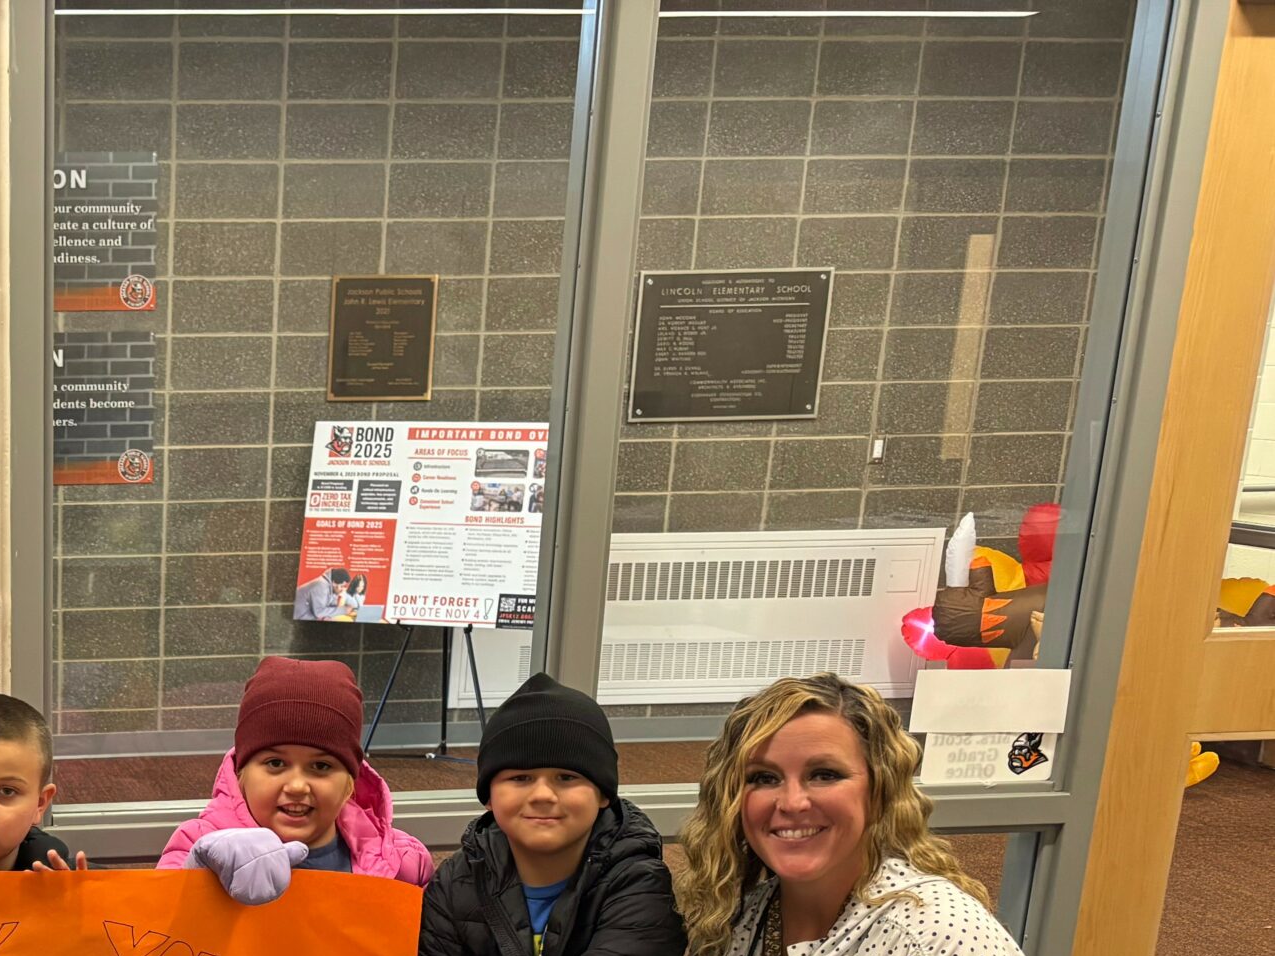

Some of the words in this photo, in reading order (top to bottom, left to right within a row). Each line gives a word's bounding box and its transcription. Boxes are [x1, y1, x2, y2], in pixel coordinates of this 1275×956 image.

[75, 202, 141, 215] community
[82, 222, 89, 230] a
[93, 219, 137, 230] culture
[140, 219, 153, 230] of
[99, 236, 122, 247] and
[661, 288, 702, 296] LINCOLN
[713, 287, 765, 295] ELEMENTARY
[777, 285, 811, 294] SCHOOL
[61, 381, 129, 392] community
[89, 398, 135, 409] become
[53, 418, 77, 427] ers.
[356, 427, 394, 442] BOND
[415, 430, 484, 439] IMPORTANT
[490, 431, 522, 440] BOND
[354, 444, 393, 458] 2025
[485, 516, 524, 524] HIGHLIGHTS
[394, 595, 429, 605] DON'T
[433, 596, 479, 607] FORGET
[393, 607, 407, 616] TO
[411, 607, 440, 618] VOTE
[446, 609, 468, 619] NOV
[474, 611, 480, 619] 4
